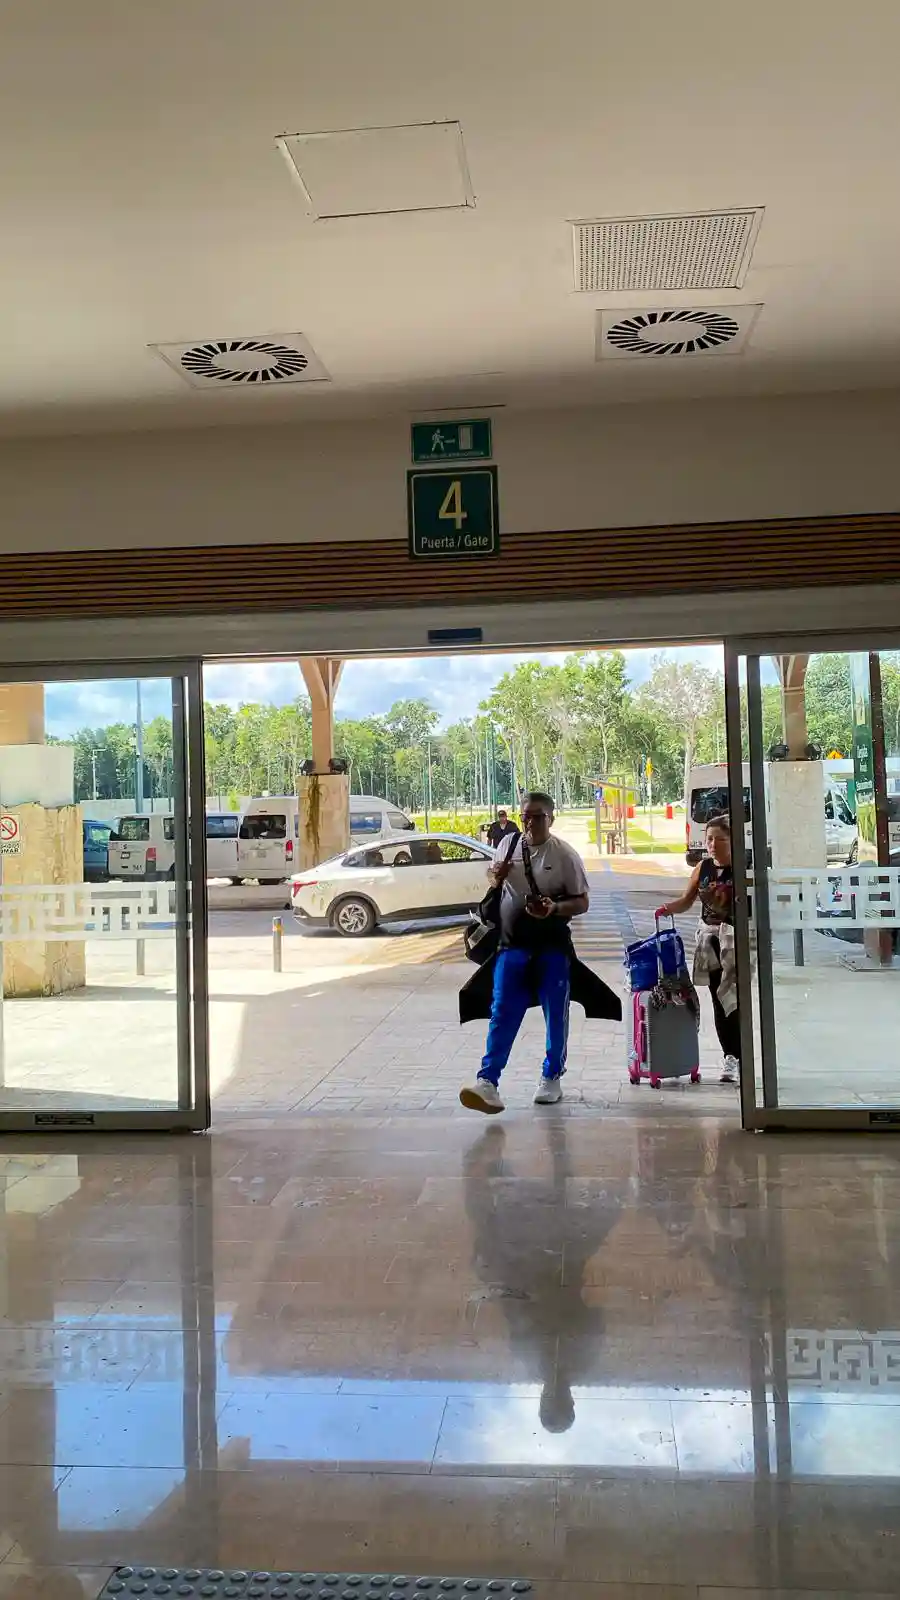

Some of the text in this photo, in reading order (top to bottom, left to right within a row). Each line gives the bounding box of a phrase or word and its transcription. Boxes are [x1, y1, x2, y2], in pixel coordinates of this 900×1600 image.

[438, 480, 467, 530] 4
[421, 536, 456, 549] Puerta
[464, 534, 488, 547] Gate
